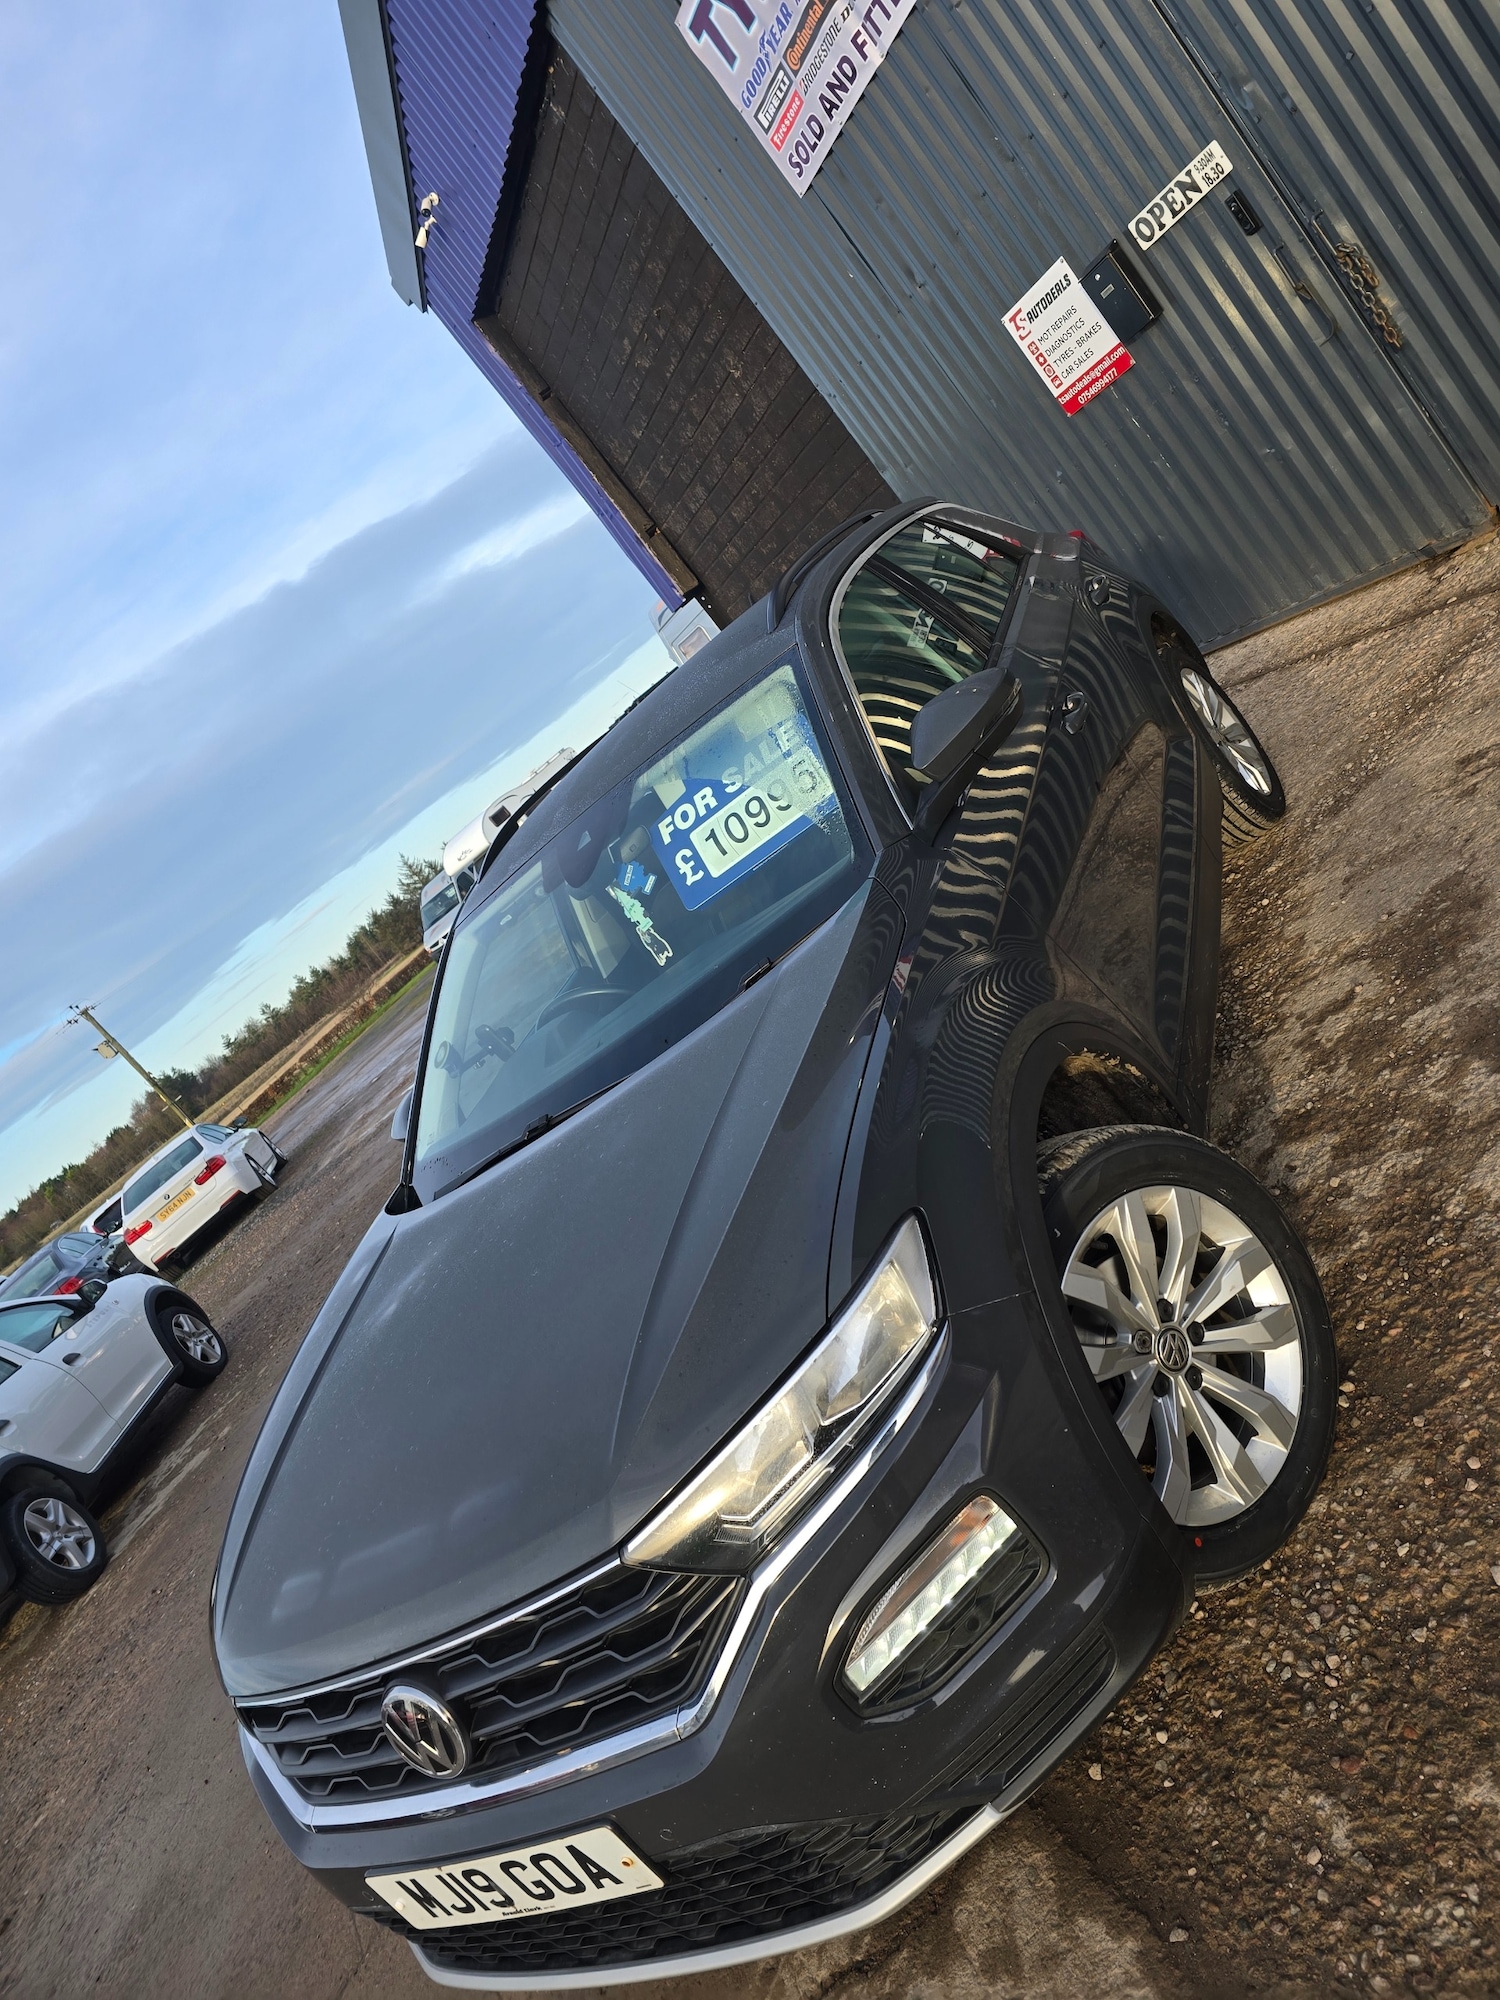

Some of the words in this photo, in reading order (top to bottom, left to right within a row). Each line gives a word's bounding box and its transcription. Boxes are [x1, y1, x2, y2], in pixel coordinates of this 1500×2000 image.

[689, 0, 758, 70] TY
[741, 2, 792, 109] GOODYEAR
[786, 1, 824, 70] Continental
[799, 17, 842, 96] BRIDGESTONE
[757, 70, 789, 129] PIRELLI
[788, 114, 825, 177] SOLD
[818, 55, 857, 121] AND
[850, 0, 902, 61] FITT
[773, 96, 800, 147] Firestone
[1193, 148, 1216, 173] 9.30AM
[1202, 162, 1224, 187] 18.30
[1135, 169, 1202, 242] OPEN
[1026, 273, 1072, 324] AUTODEALS
[1037, 328, 1052, 345] MOT
[1050, 305, 1077, 332] REPAIRS
[1044, 317, 1085, 357] DIAGNOSTICS
[1053, 347, 1075, 367] TYRES
[1075, 321, 1102, 348] BRAKES
[1061, 364, 1075, 379] CAR
[1073, 347, 1094, 368] SALES
[1058, 346, 1126, 404] tsautodeals@gmail.com
[1077, 367, 1118, 404] 07546994177
[657, 786, 718, 845] FOR
[721, 719, 799, 793] SALE
[704, 759, 818, 857] 10995
[160, 1201, 178, 1219] SY64
[395, 1868, 516, 1918] MJ19
[499, 1844, 624, 1901] GOA
